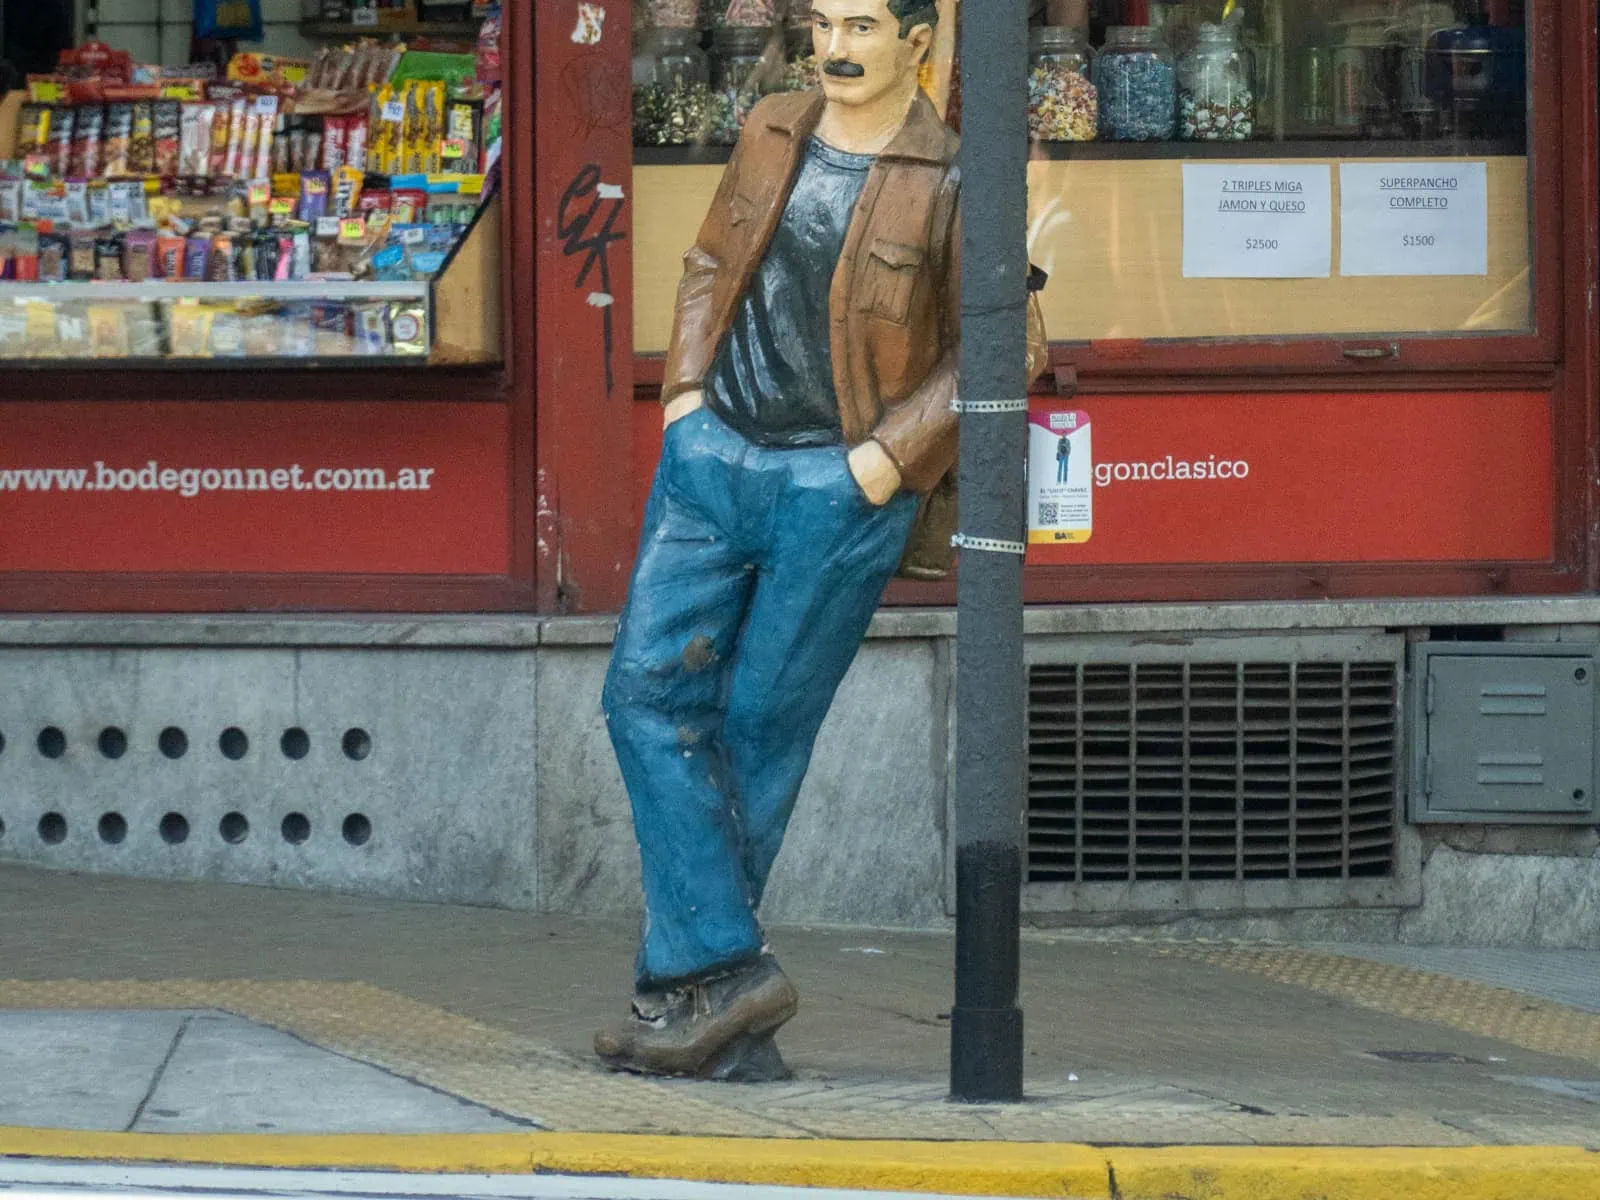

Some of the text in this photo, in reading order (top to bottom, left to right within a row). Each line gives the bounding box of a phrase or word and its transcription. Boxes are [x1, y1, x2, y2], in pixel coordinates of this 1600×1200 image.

[1222, 180, 1303, 192] 2 TRIPLES MIGA
[1380, 177, 1458, 189] SUPERPANCHO
[1218, 199, 1305, 212] JAMON Y QUESO
[1390, 196, 1448, 208] COMPLETO
[1245, 238, 1278, 250] $2500
[1402, 235, 1435, 247] $1500
[1091, 455, 1249, 487] gonclasico
[0, 461, 435, 497] www.bodegonnet.com.ar
